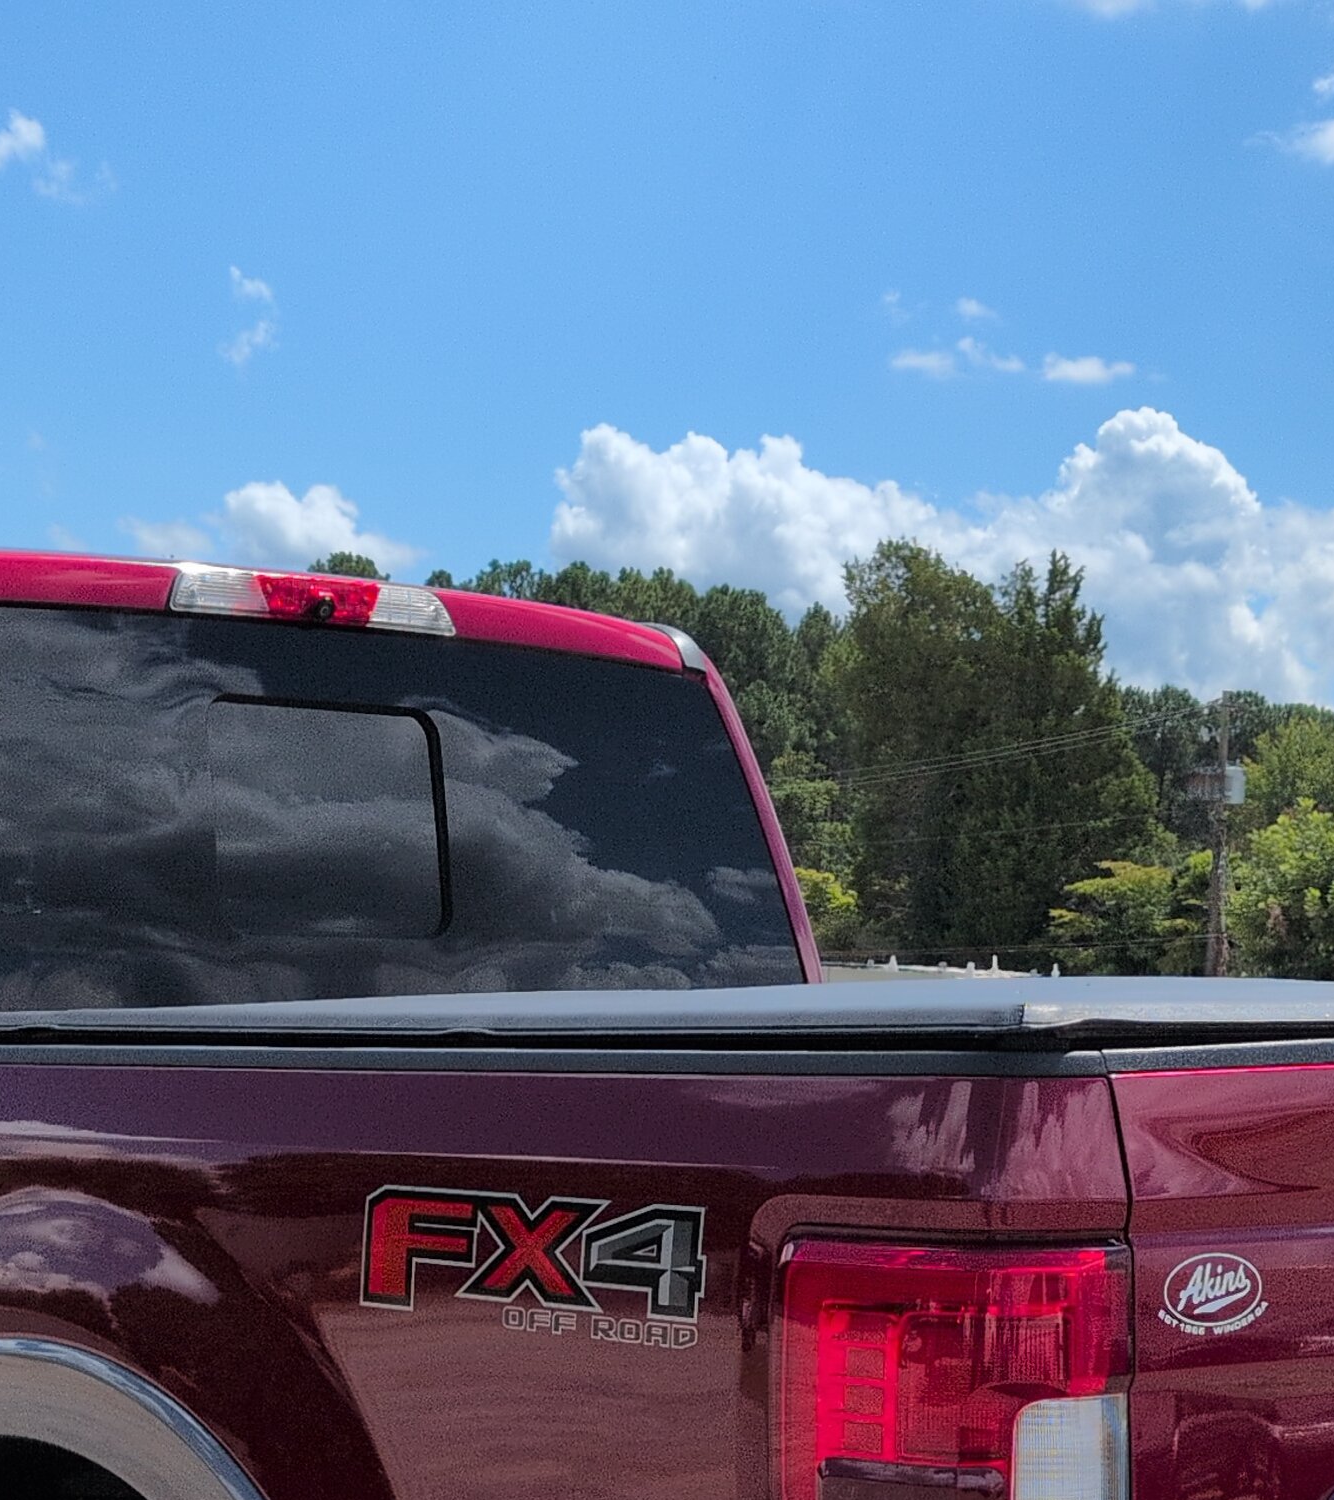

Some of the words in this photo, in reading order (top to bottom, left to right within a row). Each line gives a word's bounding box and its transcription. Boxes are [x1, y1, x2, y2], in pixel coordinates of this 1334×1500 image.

[359, 1184, 707, 1323] FX4
[1177, 1262, 1251, 1313] Akins
[502, 1306, 577, 1334] OFF
[590, 1316, 698, 1349] ROAD
